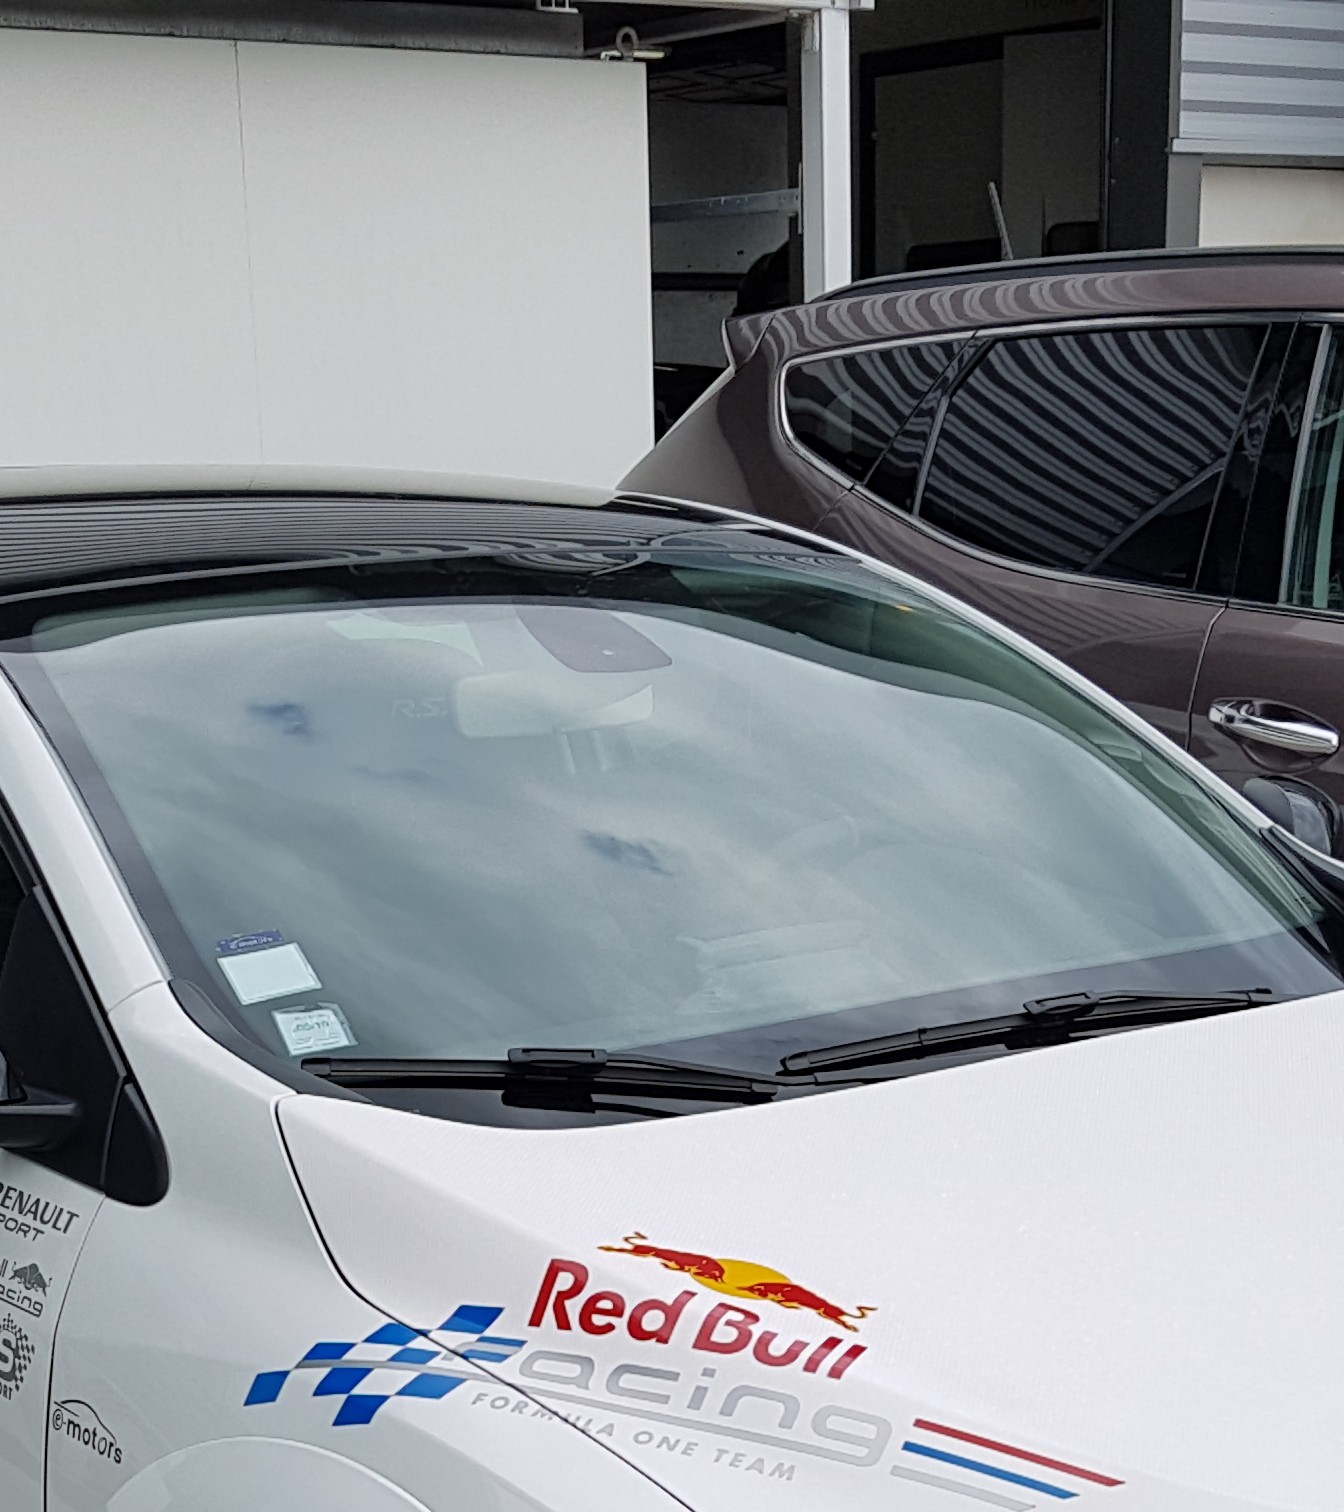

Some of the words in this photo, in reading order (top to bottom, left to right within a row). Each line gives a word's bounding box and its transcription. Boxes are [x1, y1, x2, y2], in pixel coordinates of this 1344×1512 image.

[528, 1258, 698, 1345] Red
[692, 1301, 869, 1380] Bull
[52, 1408, 123, 1465] e-motors
[471, 1392, 617, 1438] FORMULA
[631, 1429, 699, 1458] ONE
[712, 1447, 797, 1482] TEAM
